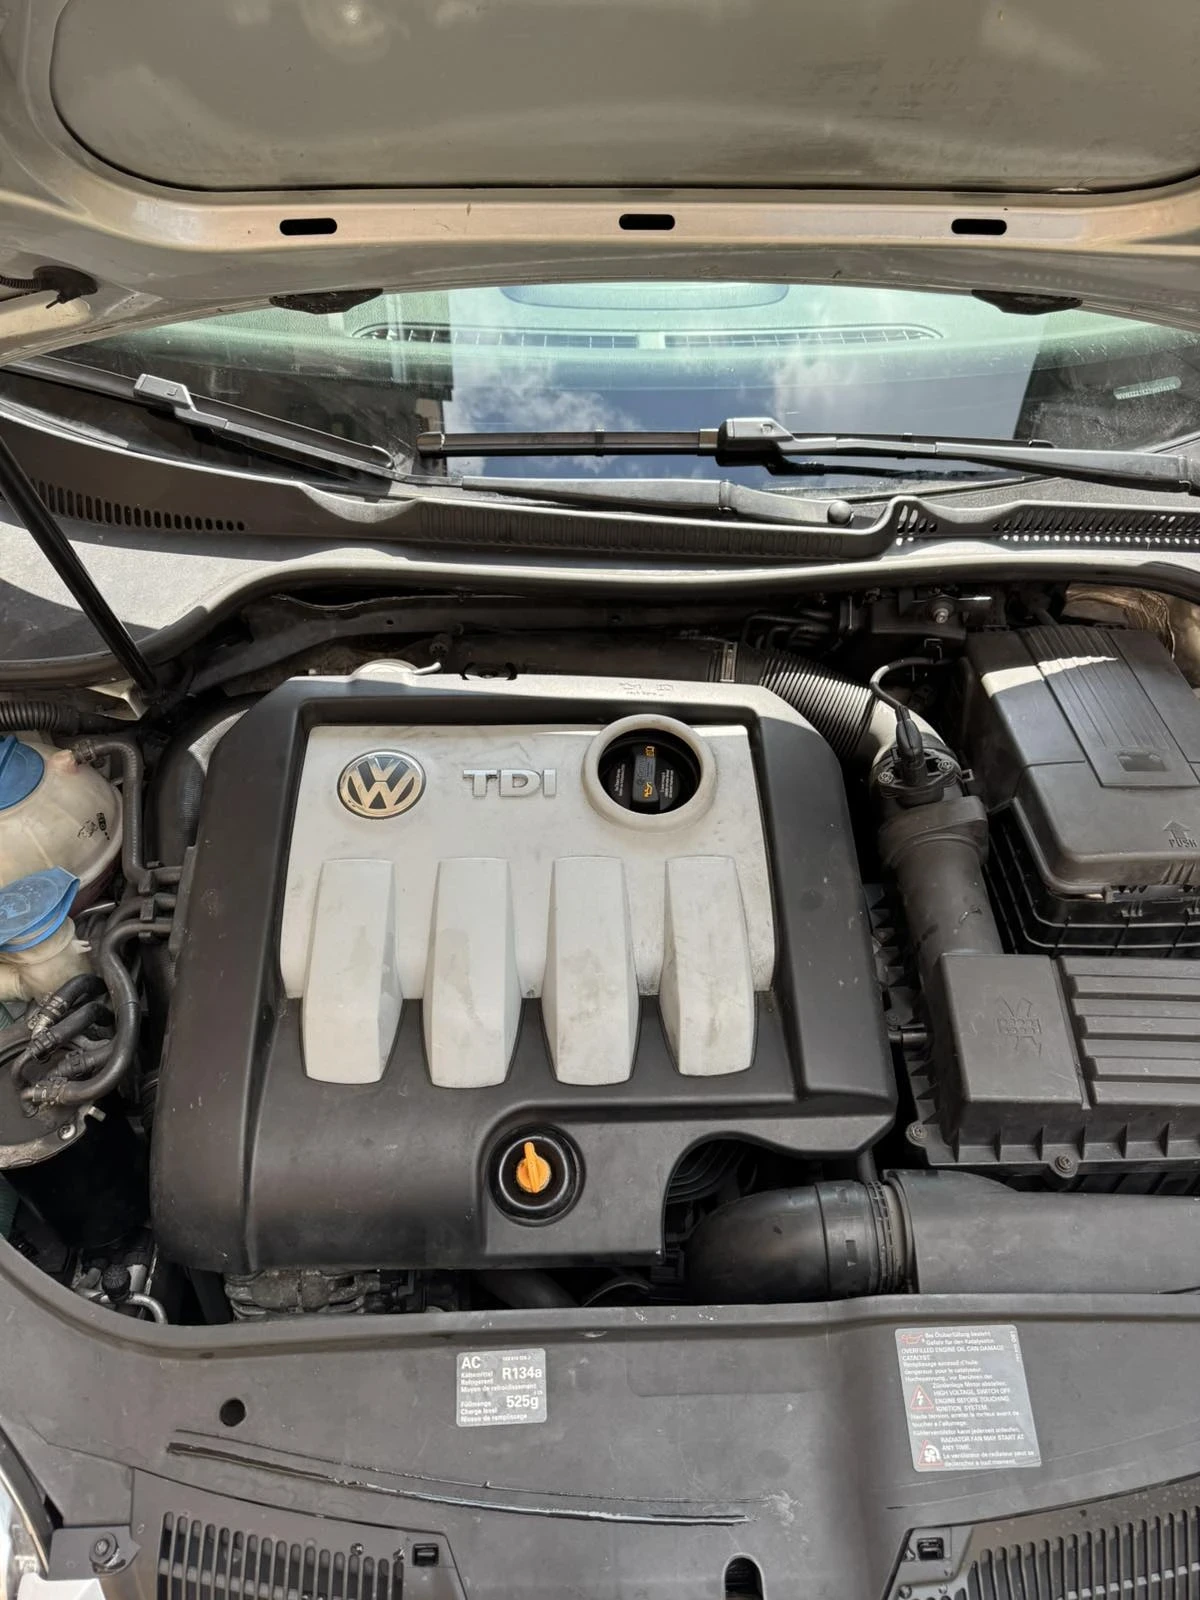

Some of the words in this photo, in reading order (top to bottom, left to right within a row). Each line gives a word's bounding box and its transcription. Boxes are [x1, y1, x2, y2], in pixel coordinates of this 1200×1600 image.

[340, 751, 424, 817] VW
[462, 769, 557, 798] TDI
[1168, 839, 1197, 848] PUSH
[462, 1356, 480, 1368] AC
[502, 1366, 542, 1379] R134a
[506, 1395, 538, 1409] 525g
